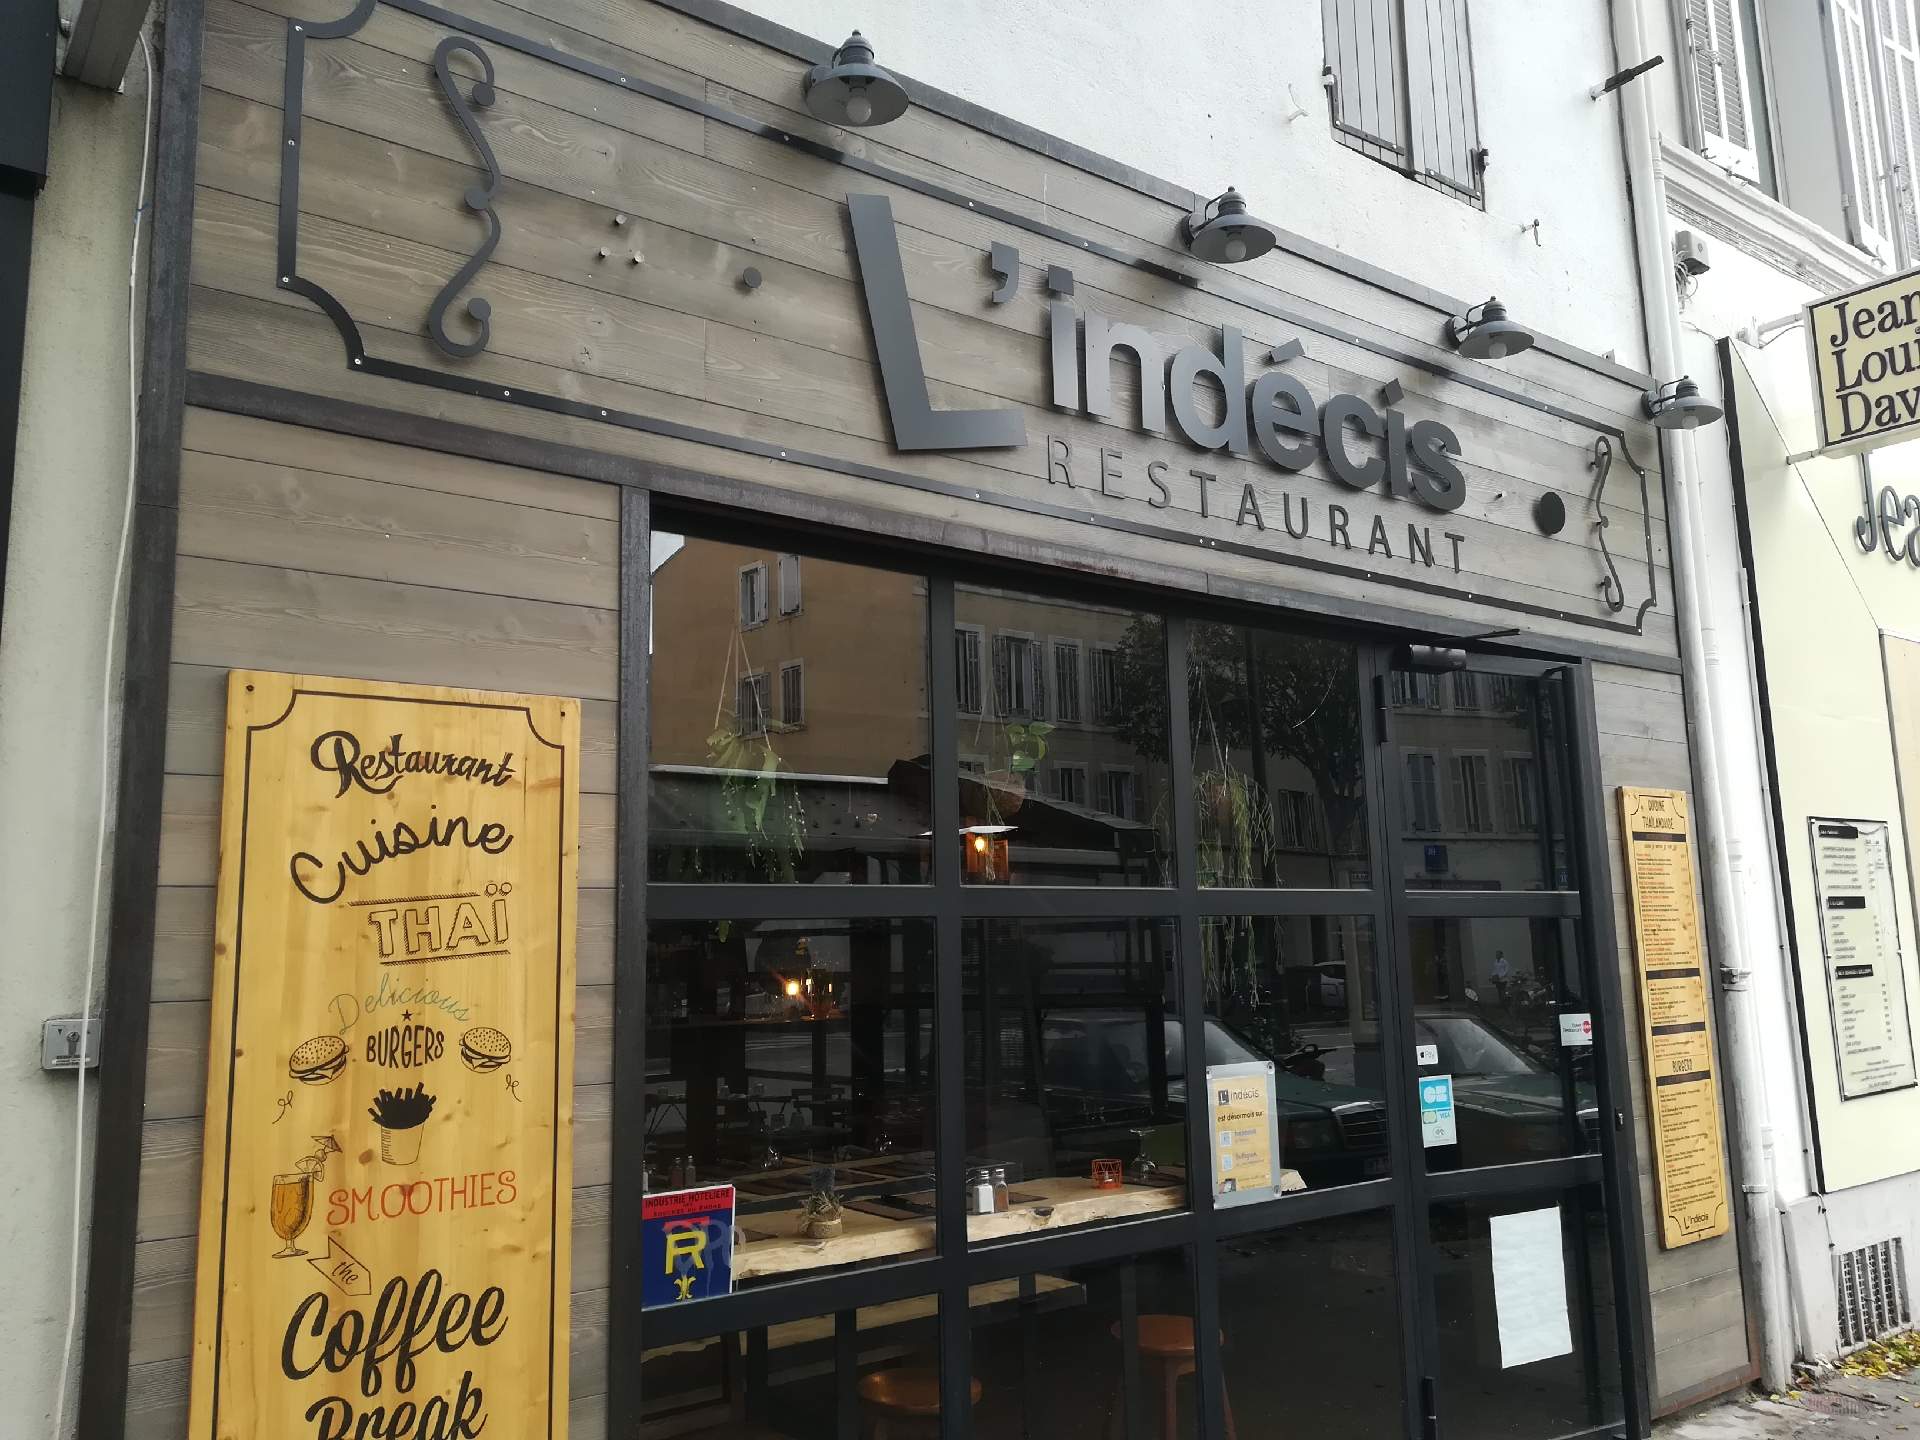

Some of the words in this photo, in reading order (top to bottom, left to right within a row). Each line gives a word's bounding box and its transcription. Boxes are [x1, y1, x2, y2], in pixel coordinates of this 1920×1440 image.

[846, 192, 1467, 512] L'indécis
[1046, 434, 1466, 574] RESTAURANT
[310, 730, 516, 799] Restaurant
[290, 804, 515, 904] Cuisine
[368, 883, 513, 959] THAÏ
[328, 972, 474, 1036] Delicious
[366, 1025, 445, 1070] BURGERS
[326, 1170, 518, 1226] SMOOTHIES
[645, 1196, 686, 1209] INDUSTRIE
[331, 1262, 359, 1284] the
[281, 1268, 508, 1398] Coffee
